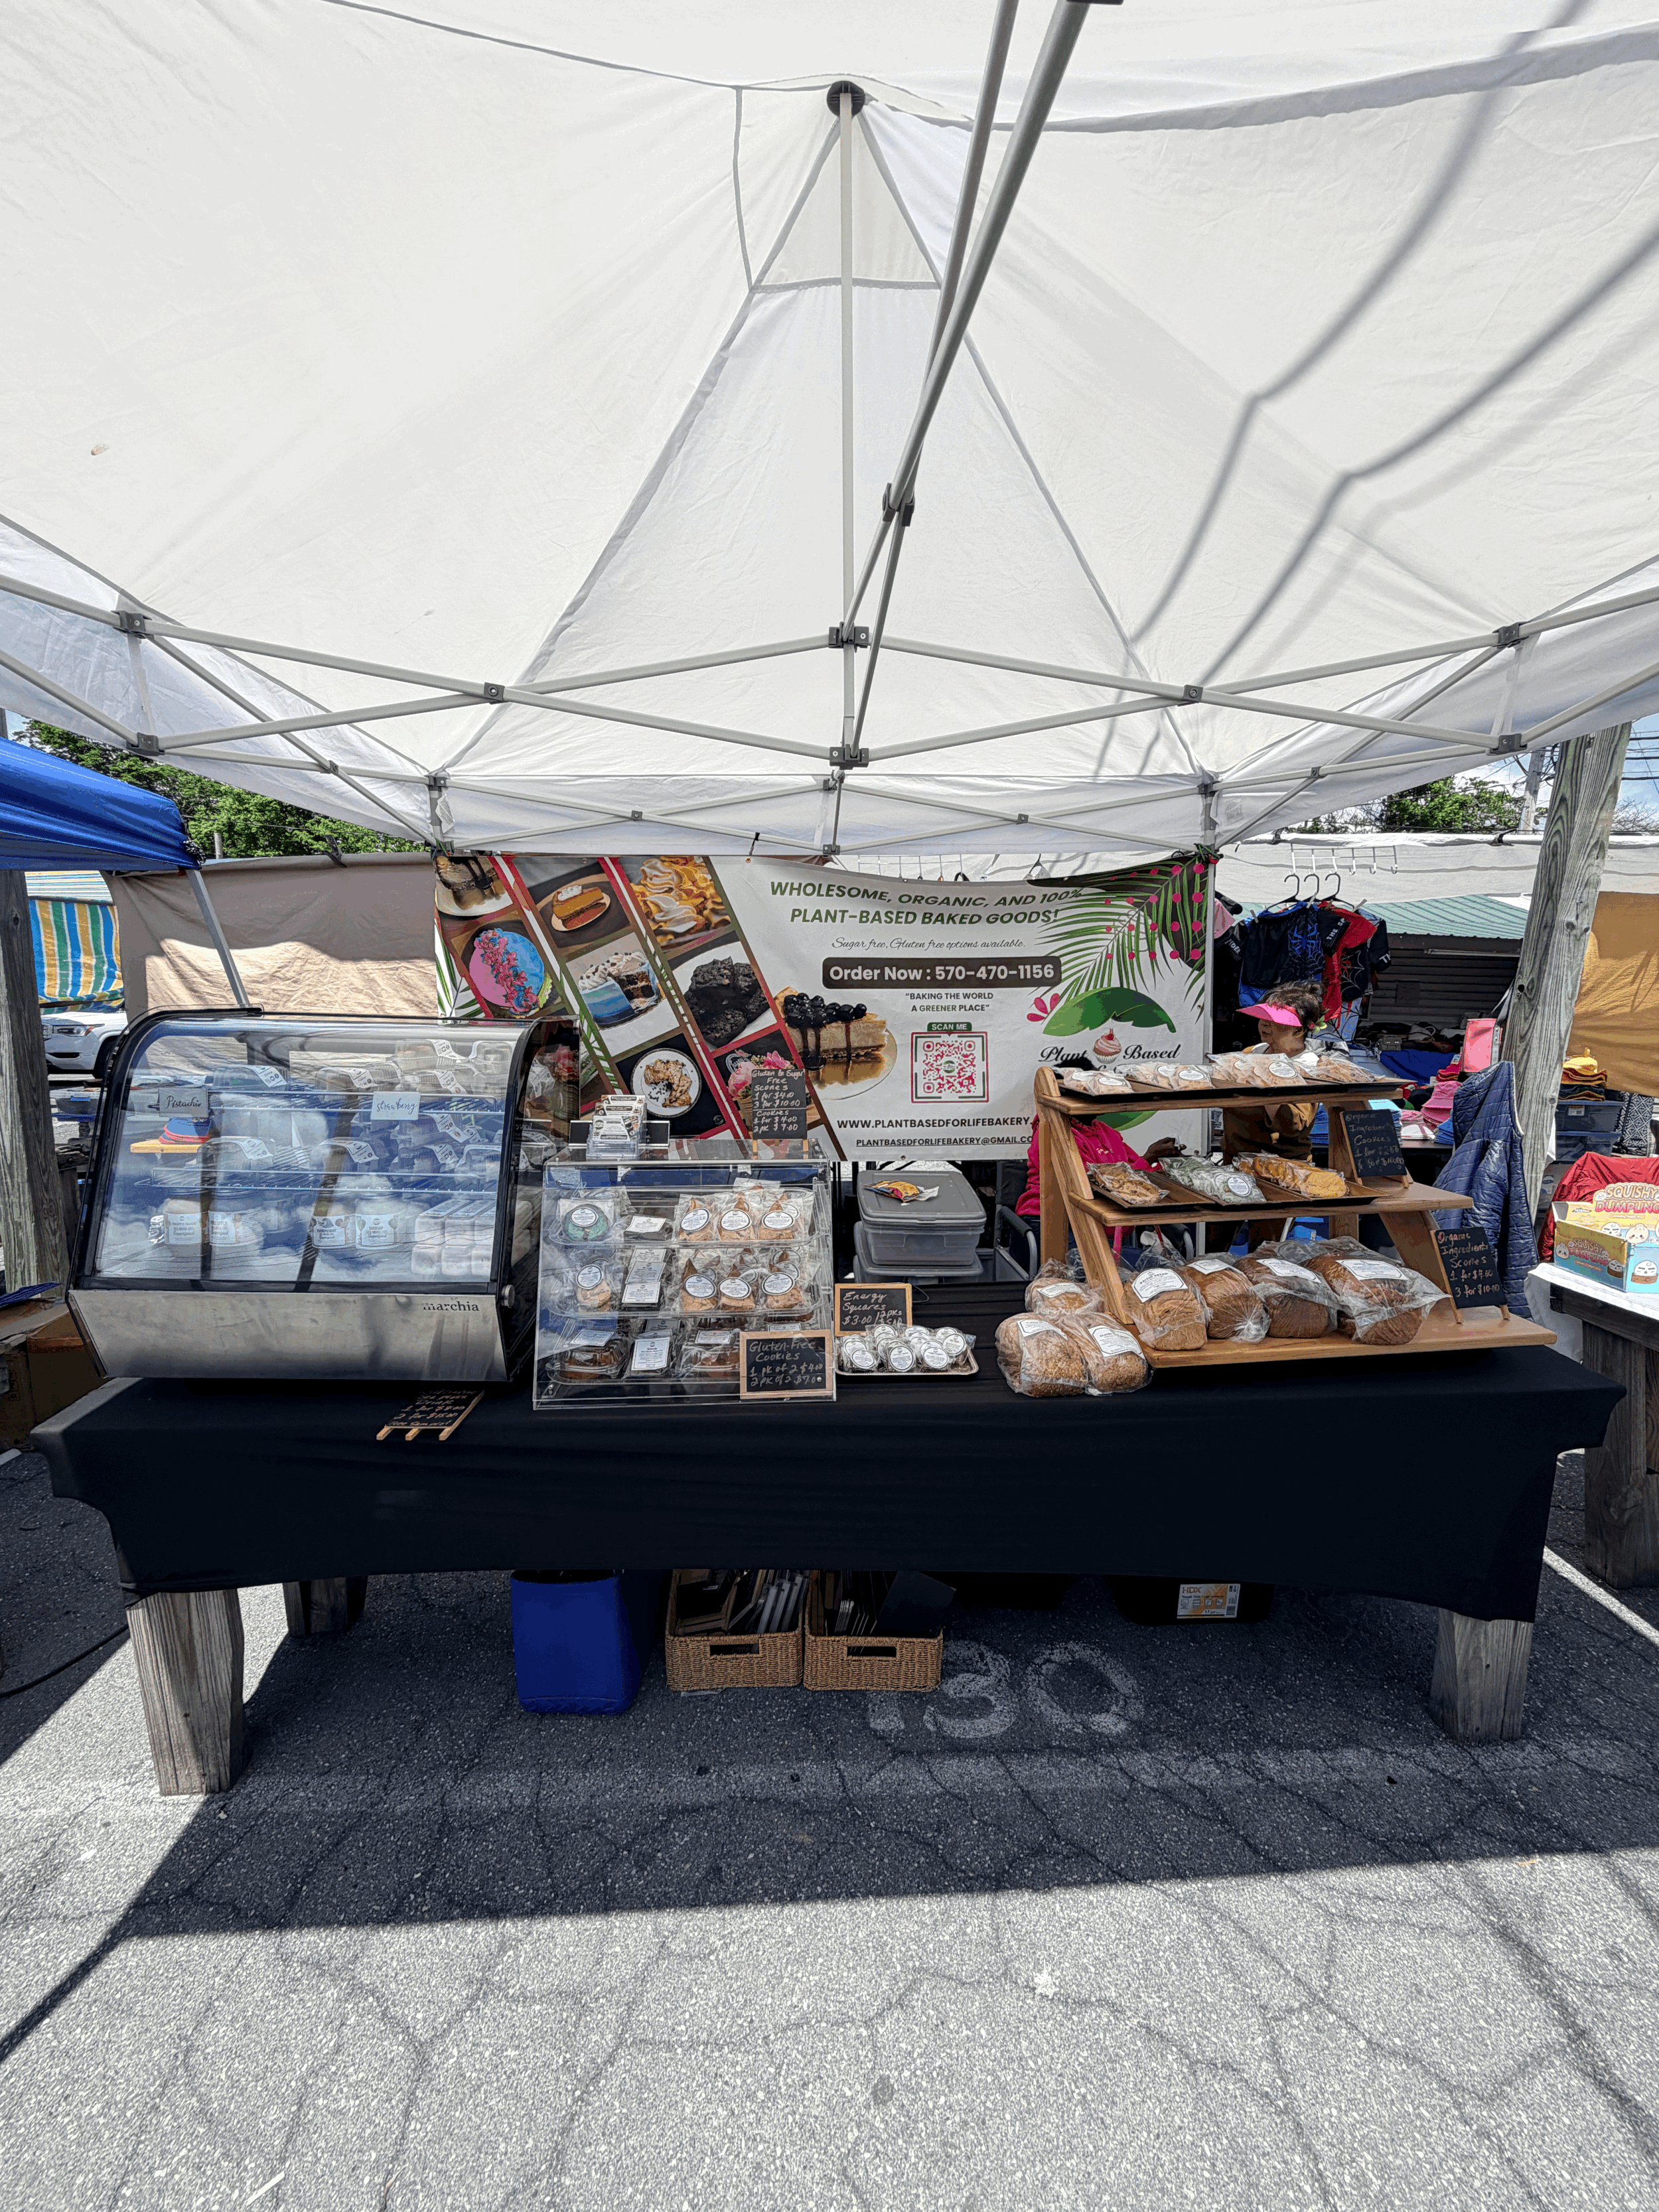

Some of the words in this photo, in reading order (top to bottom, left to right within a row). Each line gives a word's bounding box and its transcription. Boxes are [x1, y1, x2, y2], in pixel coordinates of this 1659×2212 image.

[770, 881, 893, 903] WHOLESOME,
[898, 894, 989, 907] ORGANIC,
[994, 895, 1036, 906] AND
[1039, 889, 1082, 903] 100%
[790, 909, 917, 924] PLANT-BASED
[921, 912, 981, 924] BAKED
[985, 909, 1059, 924] GOODS!
[1326, 928, 1338, 940] THE
[831, 937, 866, 950] Sugar
[890, 938, 926, 950] Gluten
[924, 939, 945, 951] free
[946, 940, 979, 950] options
[981, 939, 1025, 948] available.
[830, 966, 881, 980] Order
[884, 966, 923, 980] Now
[935, 964, 1054, 980] 570-470-1156
[1123, 1044, 1181, 1060] Based
[1606, 1185, 1658, 1199] SQUISHY
[843, 1291, 888, 1303] Energy
[1455, 1286, 1461, 1297] 3
[842, 1302, 887, 1314] Squares
[789, 1364, 798, 1374] 2
[794, 1375, 822, 1385] $7.0
